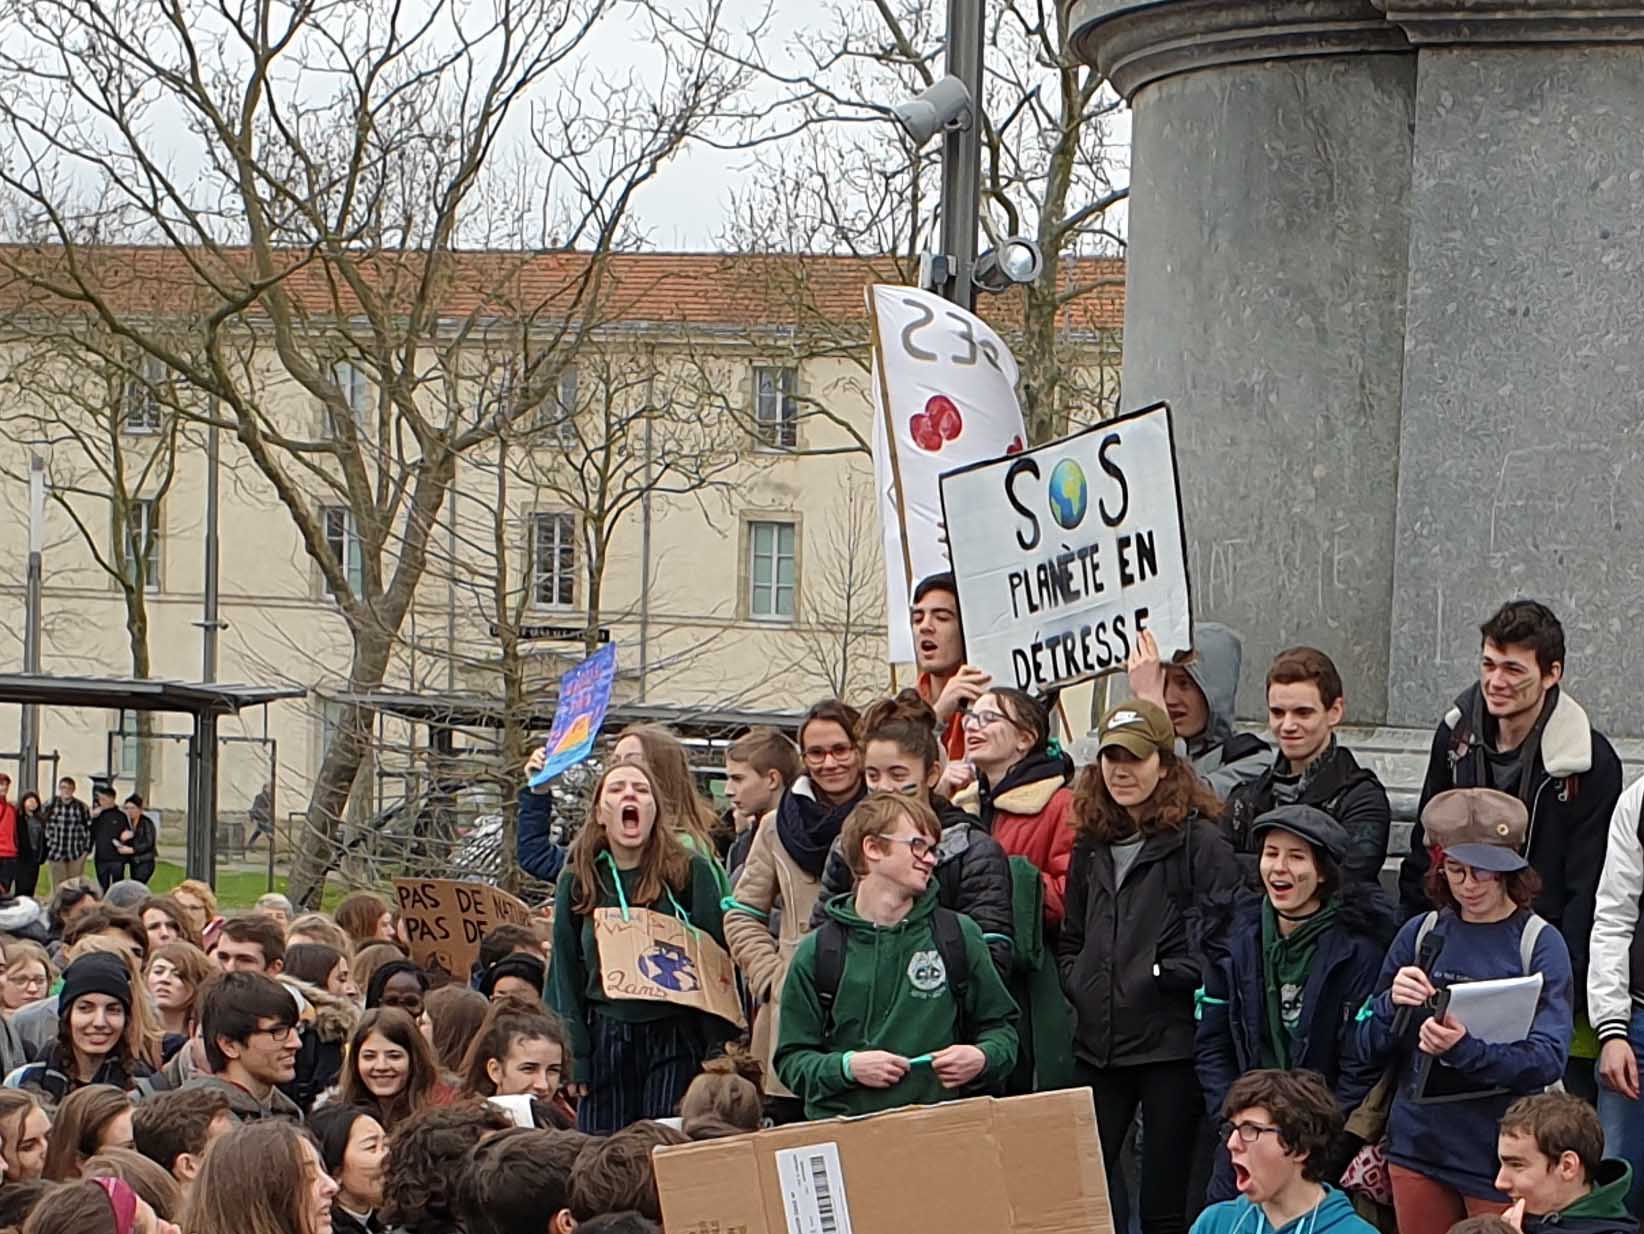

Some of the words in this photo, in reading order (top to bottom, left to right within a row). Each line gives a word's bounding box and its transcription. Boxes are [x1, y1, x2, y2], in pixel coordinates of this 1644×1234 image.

[1009, 543, 1104, 618] PLANÈTE
[1118, 530, 1158, 590] EN
[397, 884, 440, 910] PAS
[455, 888, 485, 915] DE
[406, 917, 450, 942] PAS
